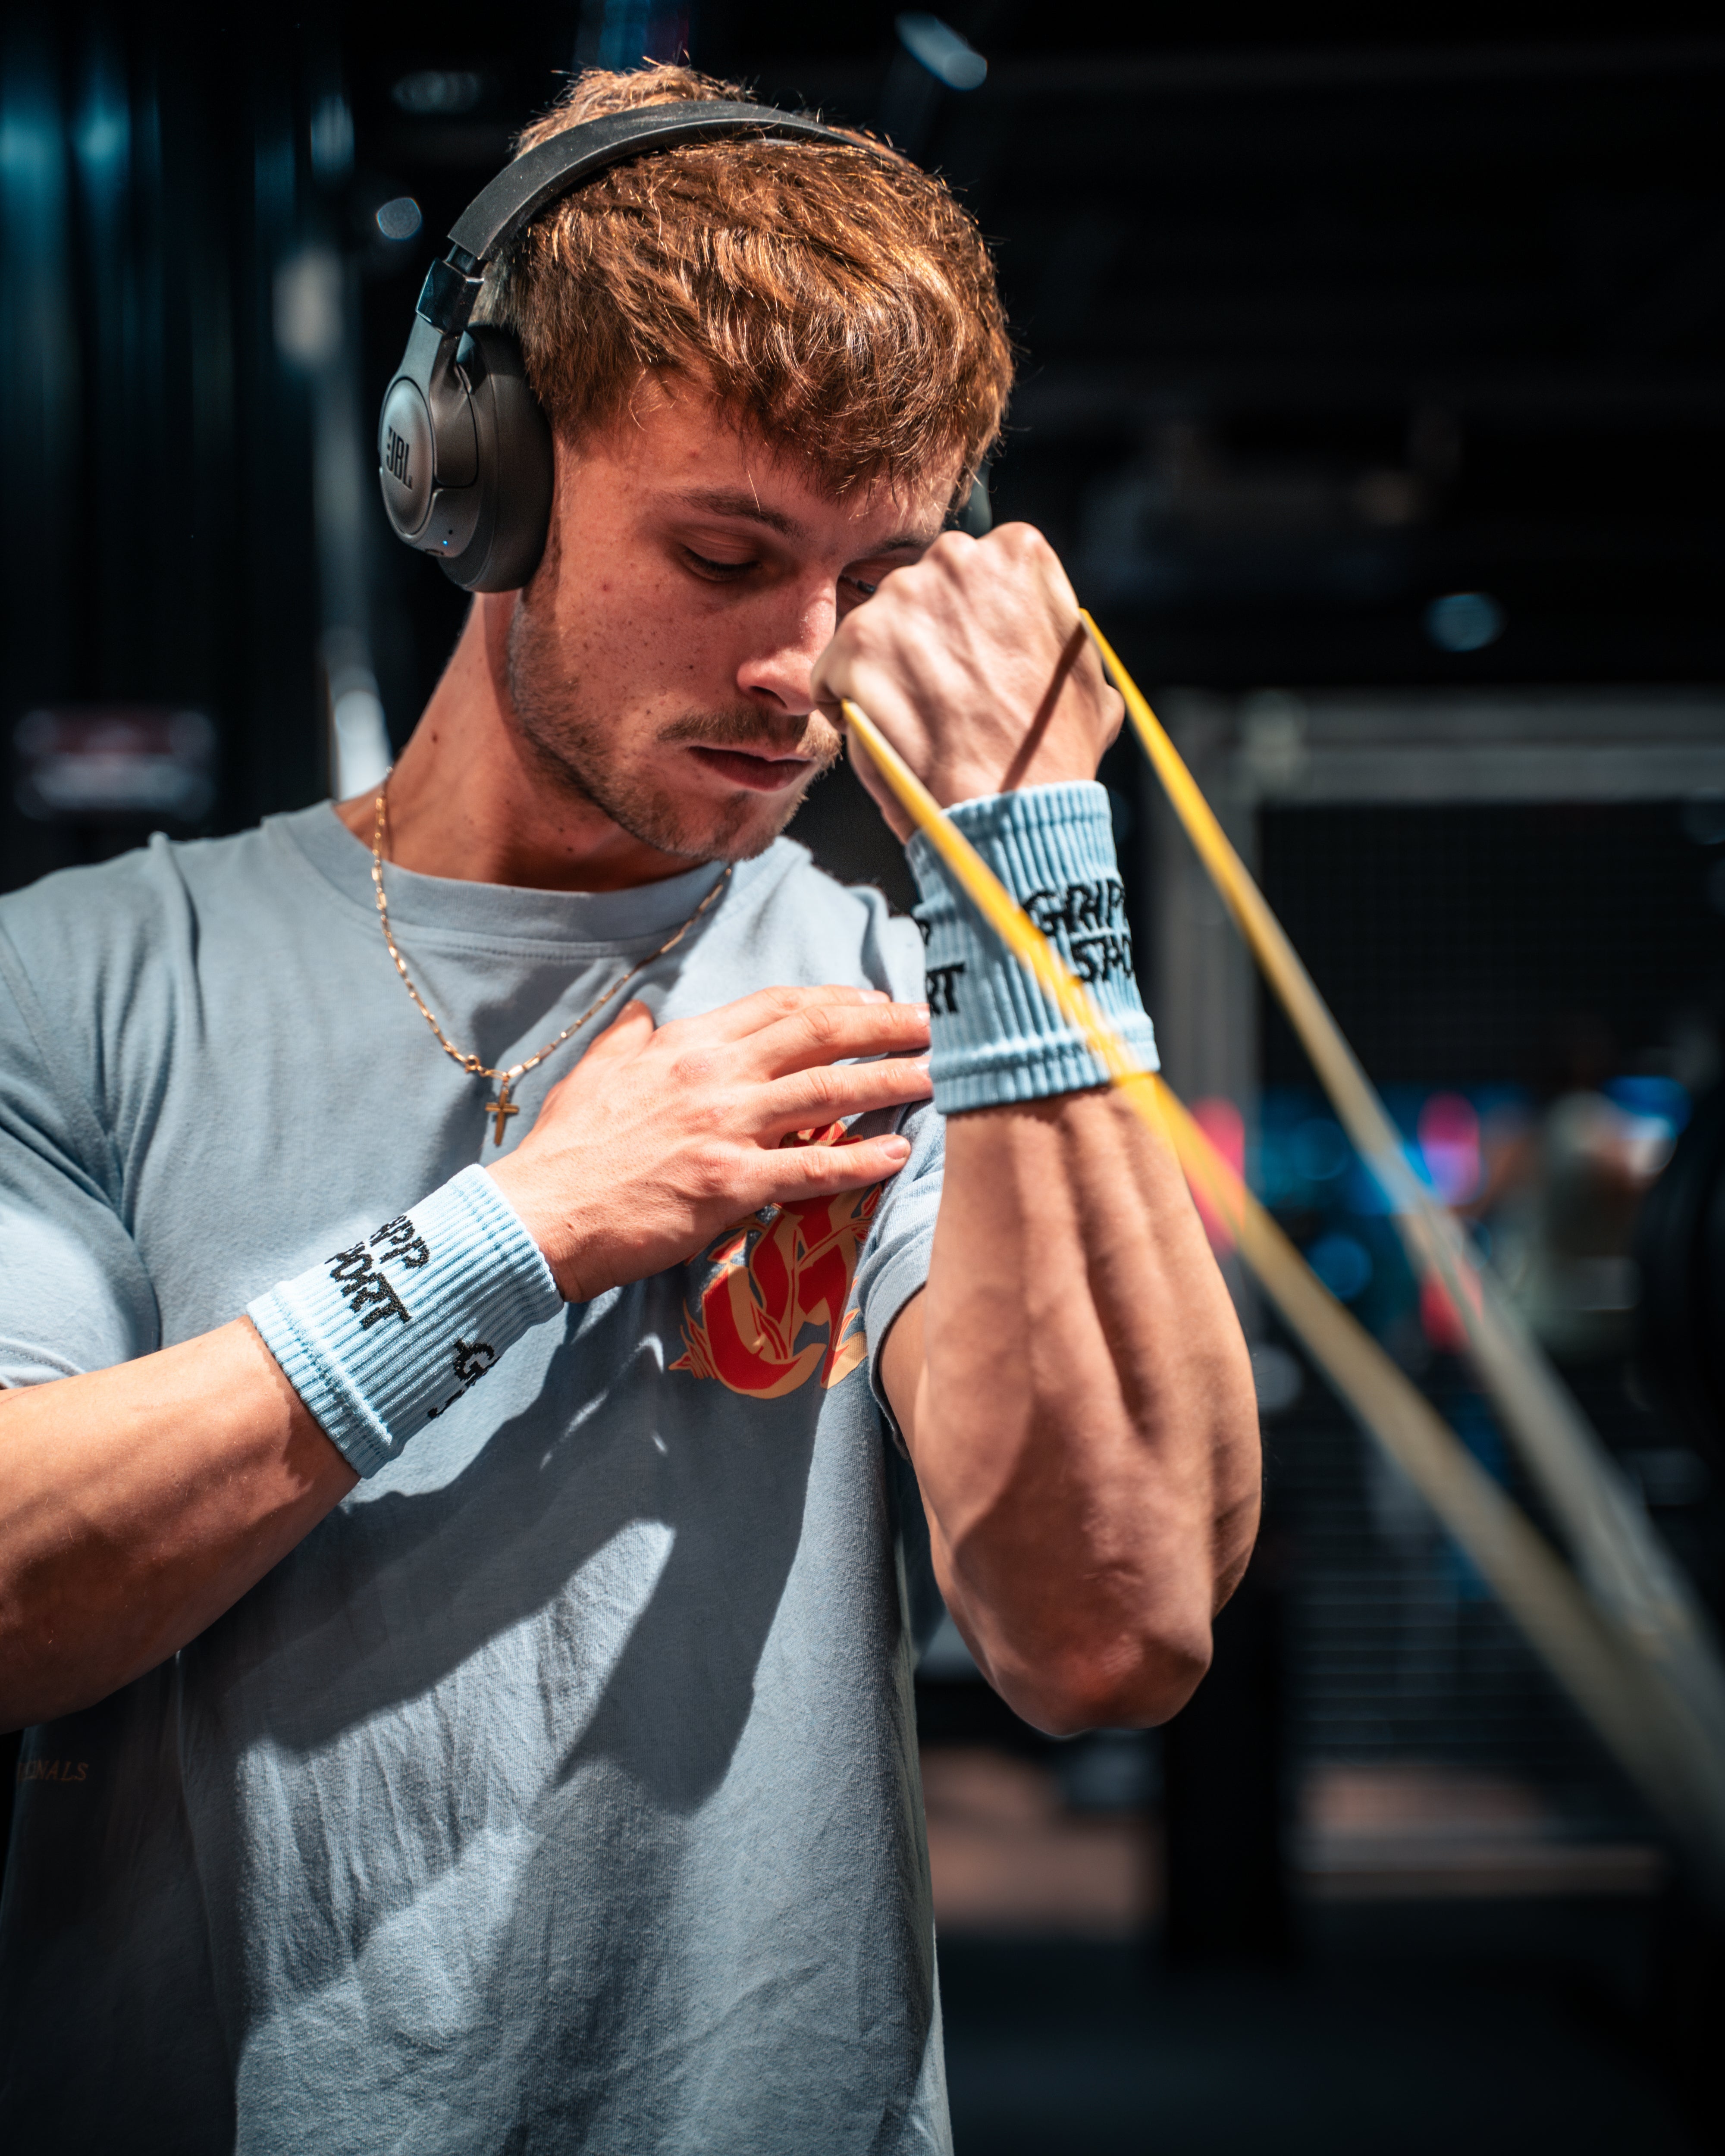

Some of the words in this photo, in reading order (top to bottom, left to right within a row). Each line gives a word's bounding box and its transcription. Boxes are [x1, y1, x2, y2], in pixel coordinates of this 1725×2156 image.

[386, 426, 412, 489] JBL
[1020, 879, 1126, 936] GRIP
[324, 1241, 412, 1330] PORT
